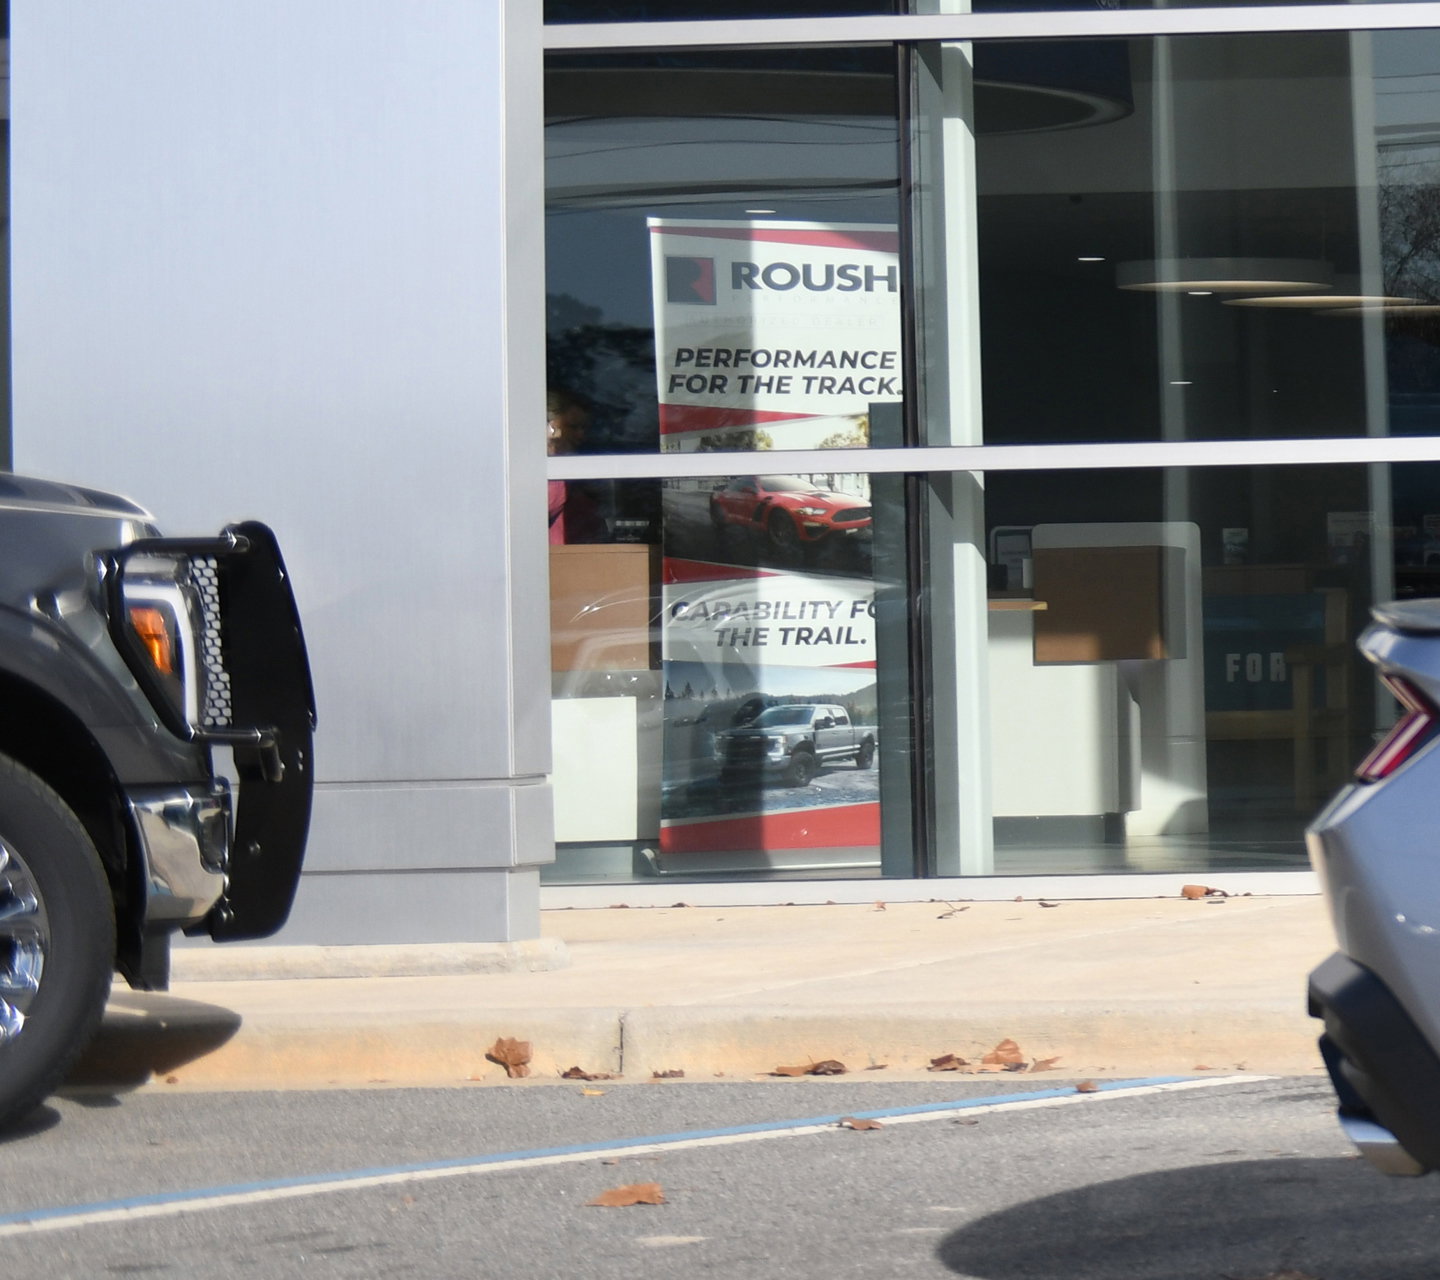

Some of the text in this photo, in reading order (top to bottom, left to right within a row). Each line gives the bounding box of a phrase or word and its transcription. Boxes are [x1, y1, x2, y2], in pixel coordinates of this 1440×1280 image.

[731, 261, 898, 293] ROUSH
[674, 348, 897, 370] PERFORMANCE
[668, 374, 903, 396] FOR THE TRACK.
[671, 600, 846, 621] CAPABILITY
[714, 626, 867, 647] THE TRAIL.
